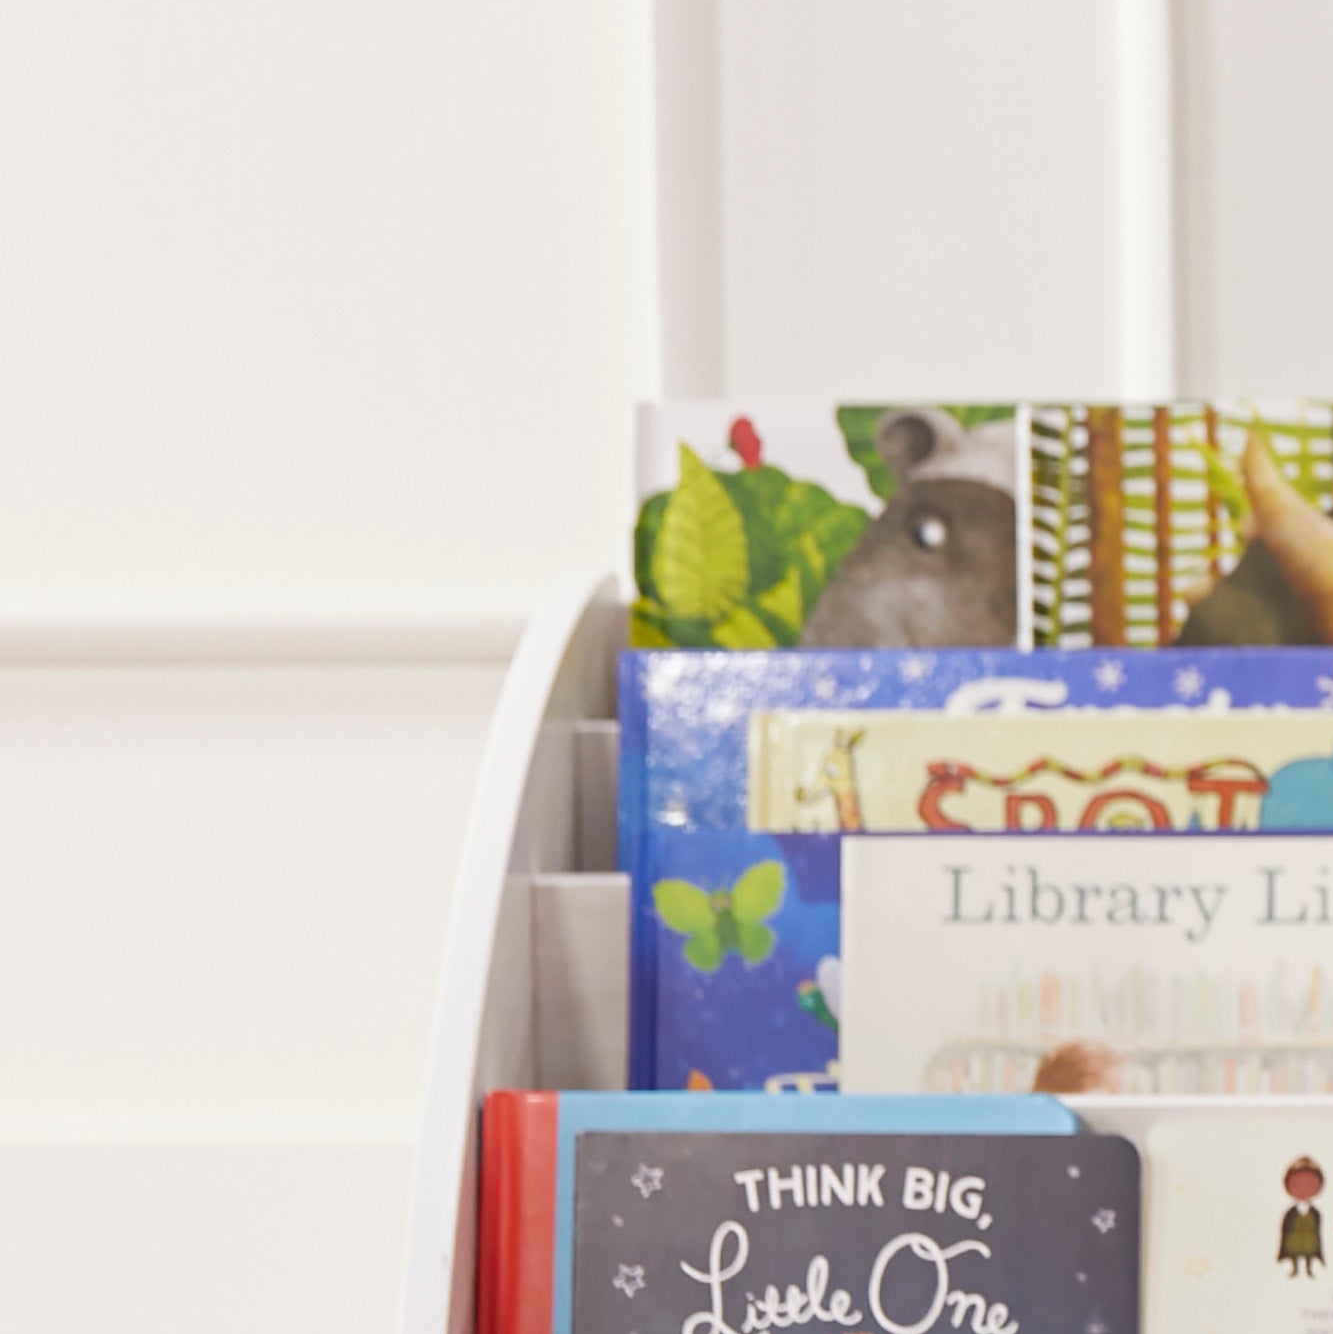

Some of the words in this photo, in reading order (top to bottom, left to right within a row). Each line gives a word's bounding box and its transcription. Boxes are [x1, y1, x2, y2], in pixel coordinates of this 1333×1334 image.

[942, 863, 1229, 945] Library
[733, 1163, 886, 1213] THINK
[902, 1165, 993, 1231] BIG,
